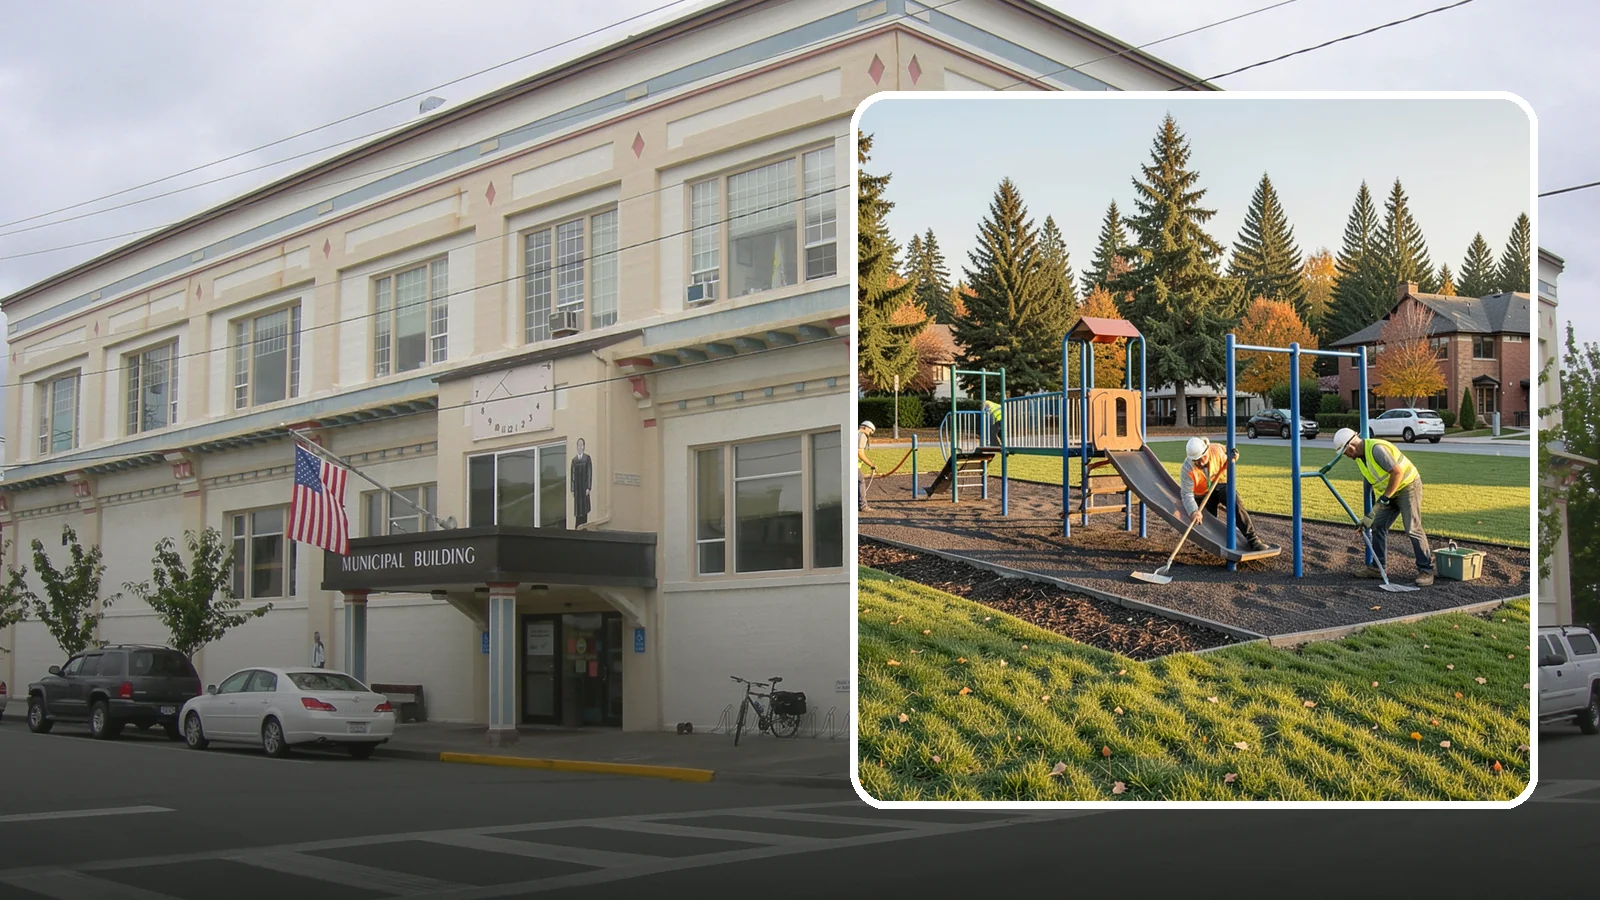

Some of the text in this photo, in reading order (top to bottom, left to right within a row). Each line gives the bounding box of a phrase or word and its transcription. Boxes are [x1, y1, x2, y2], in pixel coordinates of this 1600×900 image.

[476, 390, 479, 398] 7
[481, 407, 484, 415] 8
[488, 417, 492, 425] 9
[507, 425, 513, 433] 12
[521, 420, 525, 428] 2
[529, 414, 533, 422] 3
[342, 546, 475, 572] MUNICIPAL BUILDING
